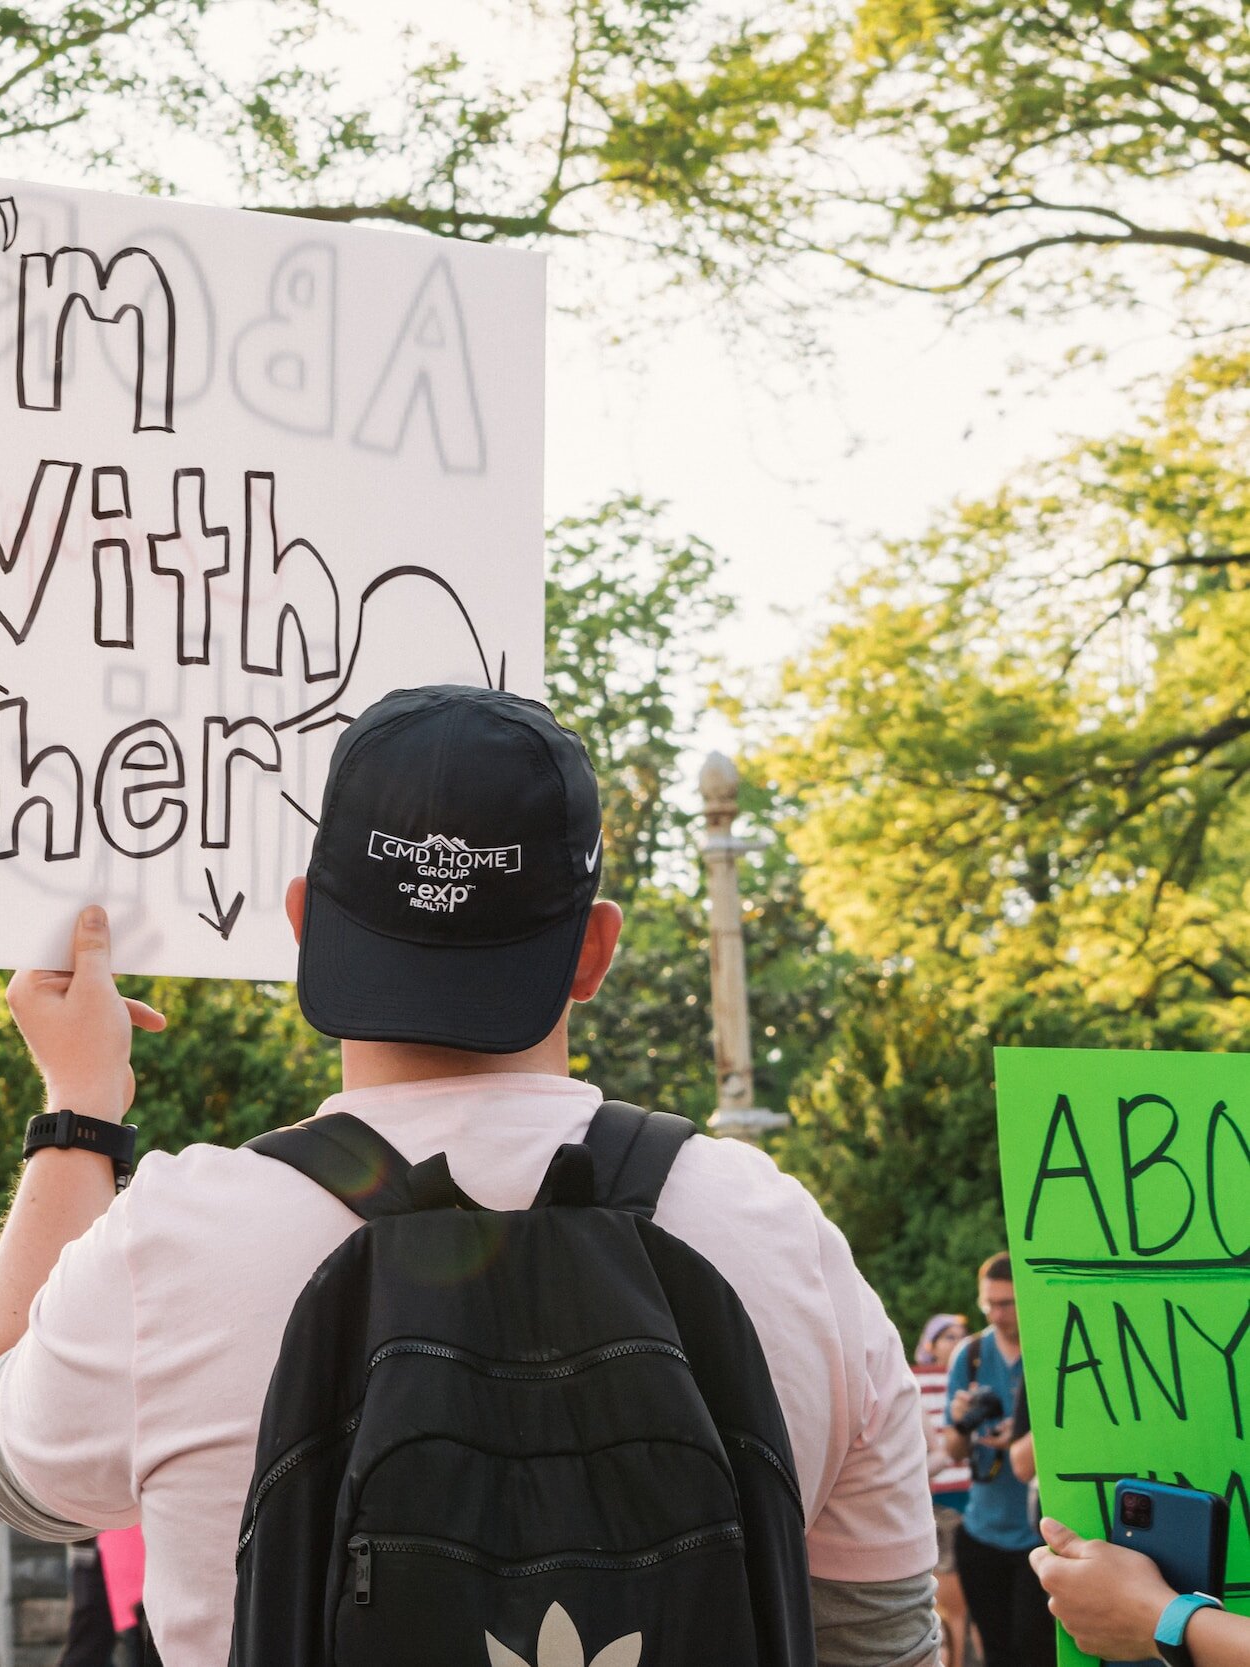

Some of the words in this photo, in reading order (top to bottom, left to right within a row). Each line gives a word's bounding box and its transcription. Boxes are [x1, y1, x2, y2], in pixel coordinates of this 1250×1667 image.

[382, 839, 431, 865] CMD
[438, 850, 507, 869] HOME
[417, 864, 470, 880] GROUP
[398, 882, 416, 894] OF
[409, 897, 450, 913] REALTY
[1055, 1298, 1250, 1440] ANY
